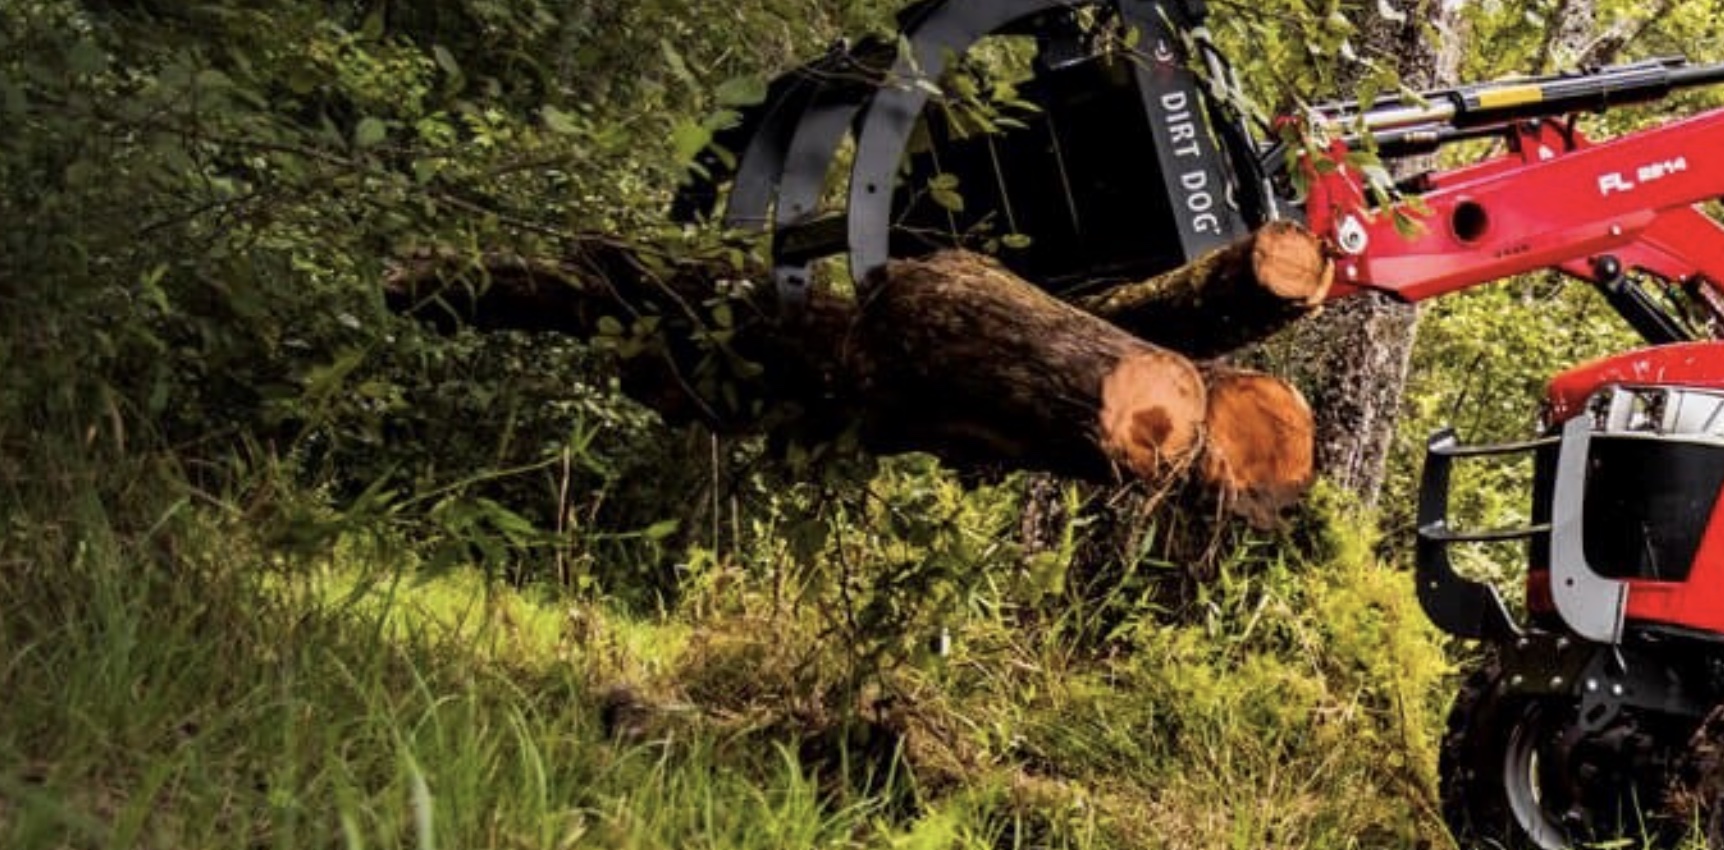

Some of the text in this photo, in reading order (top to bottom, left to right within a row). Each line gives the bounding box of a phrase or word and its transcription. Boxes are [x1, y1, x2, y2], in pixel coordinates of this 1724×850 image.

[1160, 90, 1219, 233] DIRT DOG
[1598, 171, 1634, 197] FL
